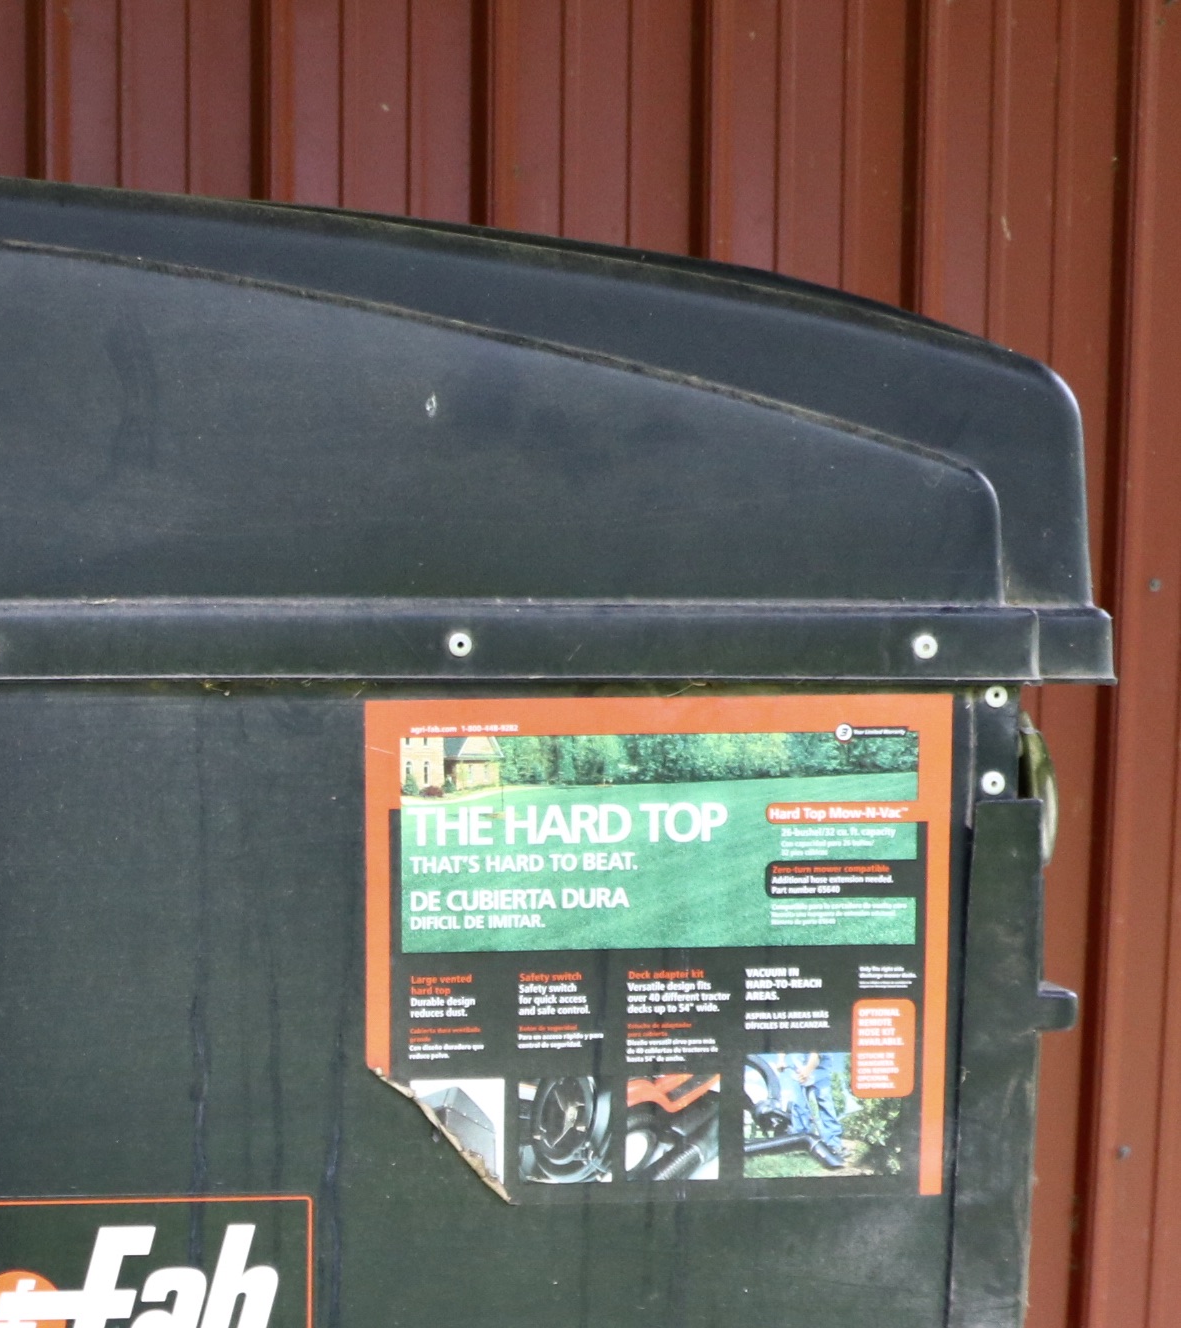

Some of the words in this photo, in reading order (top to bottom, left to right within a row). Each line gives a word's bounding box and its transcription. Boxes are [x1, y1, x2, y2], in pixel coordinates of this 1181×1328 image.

[410, 725, 457, 734] agri-fab.com
[769, 807, 800, 820] Hard
[803, 807, 826, 822] Top
[407, 805, 494, 847] THE
[505, 803, 633, 845] HARD
[639, 801, 729, 843] TOP
[860, 827, 897, 839] capacity
[409, 855, 480, 875] THAT'S
[485, 854, 545, 874] HARD
[548, 853, 578, 873] TO
[582, 851, 638, 872] BEAT.
[772, 865, 811, 874] Zero-turn
[844, 864, 891, 875] compatible
[771, 875, 810, 885] Additional
[810, 875, 828, 884] hose
[829, 875, 864, 884] extension
[865, 874, 894, 884] needed.
[771, 885, 788, 895] Part
[788, 885, 817, 895] number
[409, 890, 441, 912] DE
[445, 888, 556, 912] CUBIERTA
[561, 887, 630, 910] DURA
[409, 916, 461, 931] DIFICIL
[464, 915, 485, 930] DE
[487, 913, 546, 930] IMITAR.
[519, 972, 550, 984] Safety
[551, 971, 583, 981] switch
[628, 970, 651, 980] Deck
[653, 969, 689, 981] adapter
[691, 969, 705, 979] kit
[744, 967, 788, 978] VACUUM
[788, 967, 800, 977] IN
[410, 975, 438, 986] Large
[439, 973, 473, 984] vented
[745, 978, 823, 990] HARD-TO-REACH
[410, 986, 433, 996] hard
[434, 986, 452, 997] top
[518, 982, 548, 996] Safety
[548, 981, 577, 993] switch
[626, 980, 666, 992] Versatile
[666, 980, 696, 993] design
[696, 979, 712, 991] fits
[410, 996, 445, 1008] Durable
[446, 995, 476, 1009] design
[518, 993, 532, 1005] for
[533, 993, 558, 1007] quick
[559, 994, 587, 1004] access
[626, 993, 648, 1003] over
[648, 992, 661, 1003] 40
[661, 991, 700, 1003] different
[700, 992, 731, 1002] tractor
[744, 990, 781, 1002] AREAS.
[410, 1008, 444, 1019] reduces
[445, 1007, 468, 1018] dust.
[518, 1004, 536, 1016] and
[537, 1004, 556, 1016] safe
[557, 1003, 591, 1015] control.
[626, 1003, 653, 1014] decks
[653, 1004, 666, 1016] up
[666, 1003, 678, 1014] to
[695, 1002, 721, 1013] wide.
[858, 1008, 901, 1018] OPTIONAL
[745, 1011, 772, 1021] ASPIRA
[858, 1017, 894, 1027] REMOTE
[858, 1027, 880, 1037] HOSE
[881, 1027, 896, 1036] KIT
[857, 1037, 905, 1047] AVAILABLE.
